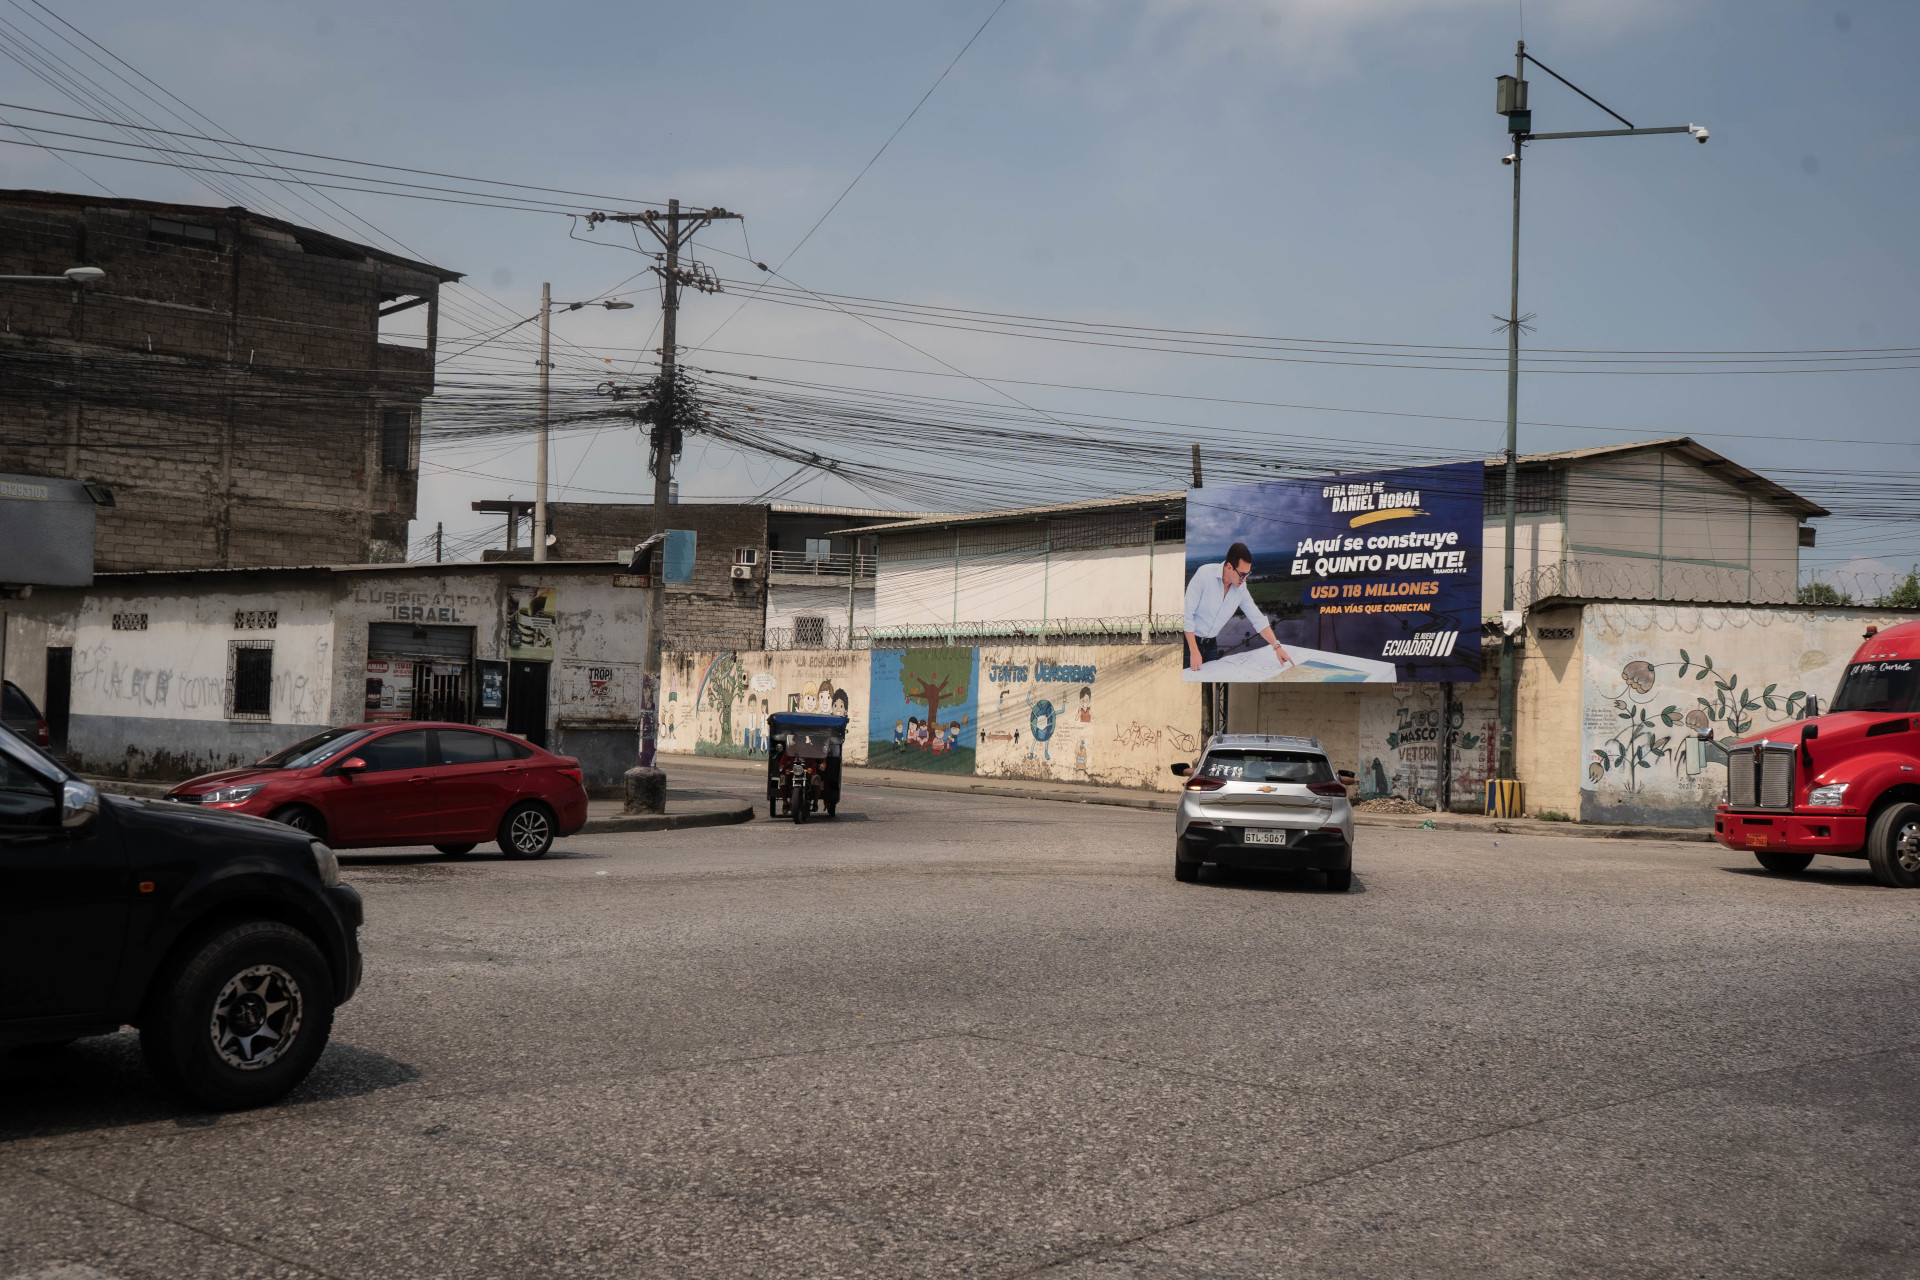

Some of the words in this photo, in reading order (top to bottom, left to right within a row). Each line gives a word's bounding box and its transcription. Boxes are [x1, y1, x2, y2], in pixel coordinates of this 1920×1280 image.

[1323, 485, 1346, 498] OTRA
[1347, 483, 1371, 496] OBRA
[1372, 481, 1386, 494] DE
[1332, 495, 1375, 513] DANIEL
[1378, 491, 1420, 510] NOBOA
[1295, 534, 1343, 557] ¡Aquí
[1343, 537, 1364, 551] se
[1367, 532, 1459, 550] construye
[1291, 559, 1311, 575] EL
[1315, 555, 1382, 577] QUINTO
[1385, 551, 1466, 571] PUENTE!
[1310, 585, 1339, 599] USD
[1342, 584, 1362, 598] 118
[1364, 581, 1440, 597] MILLONES
[1320, 606, 1342, 614] PARA
[1344, 603, 1364, 613] VÍAS
[1364, 604, 1382, 614] QUE
[1383, 603, 1431, 613] CONECTAN
[1382, 640, 1433, 656] ECUADOR
[1401, 727, 1460, 744] MASCOS
